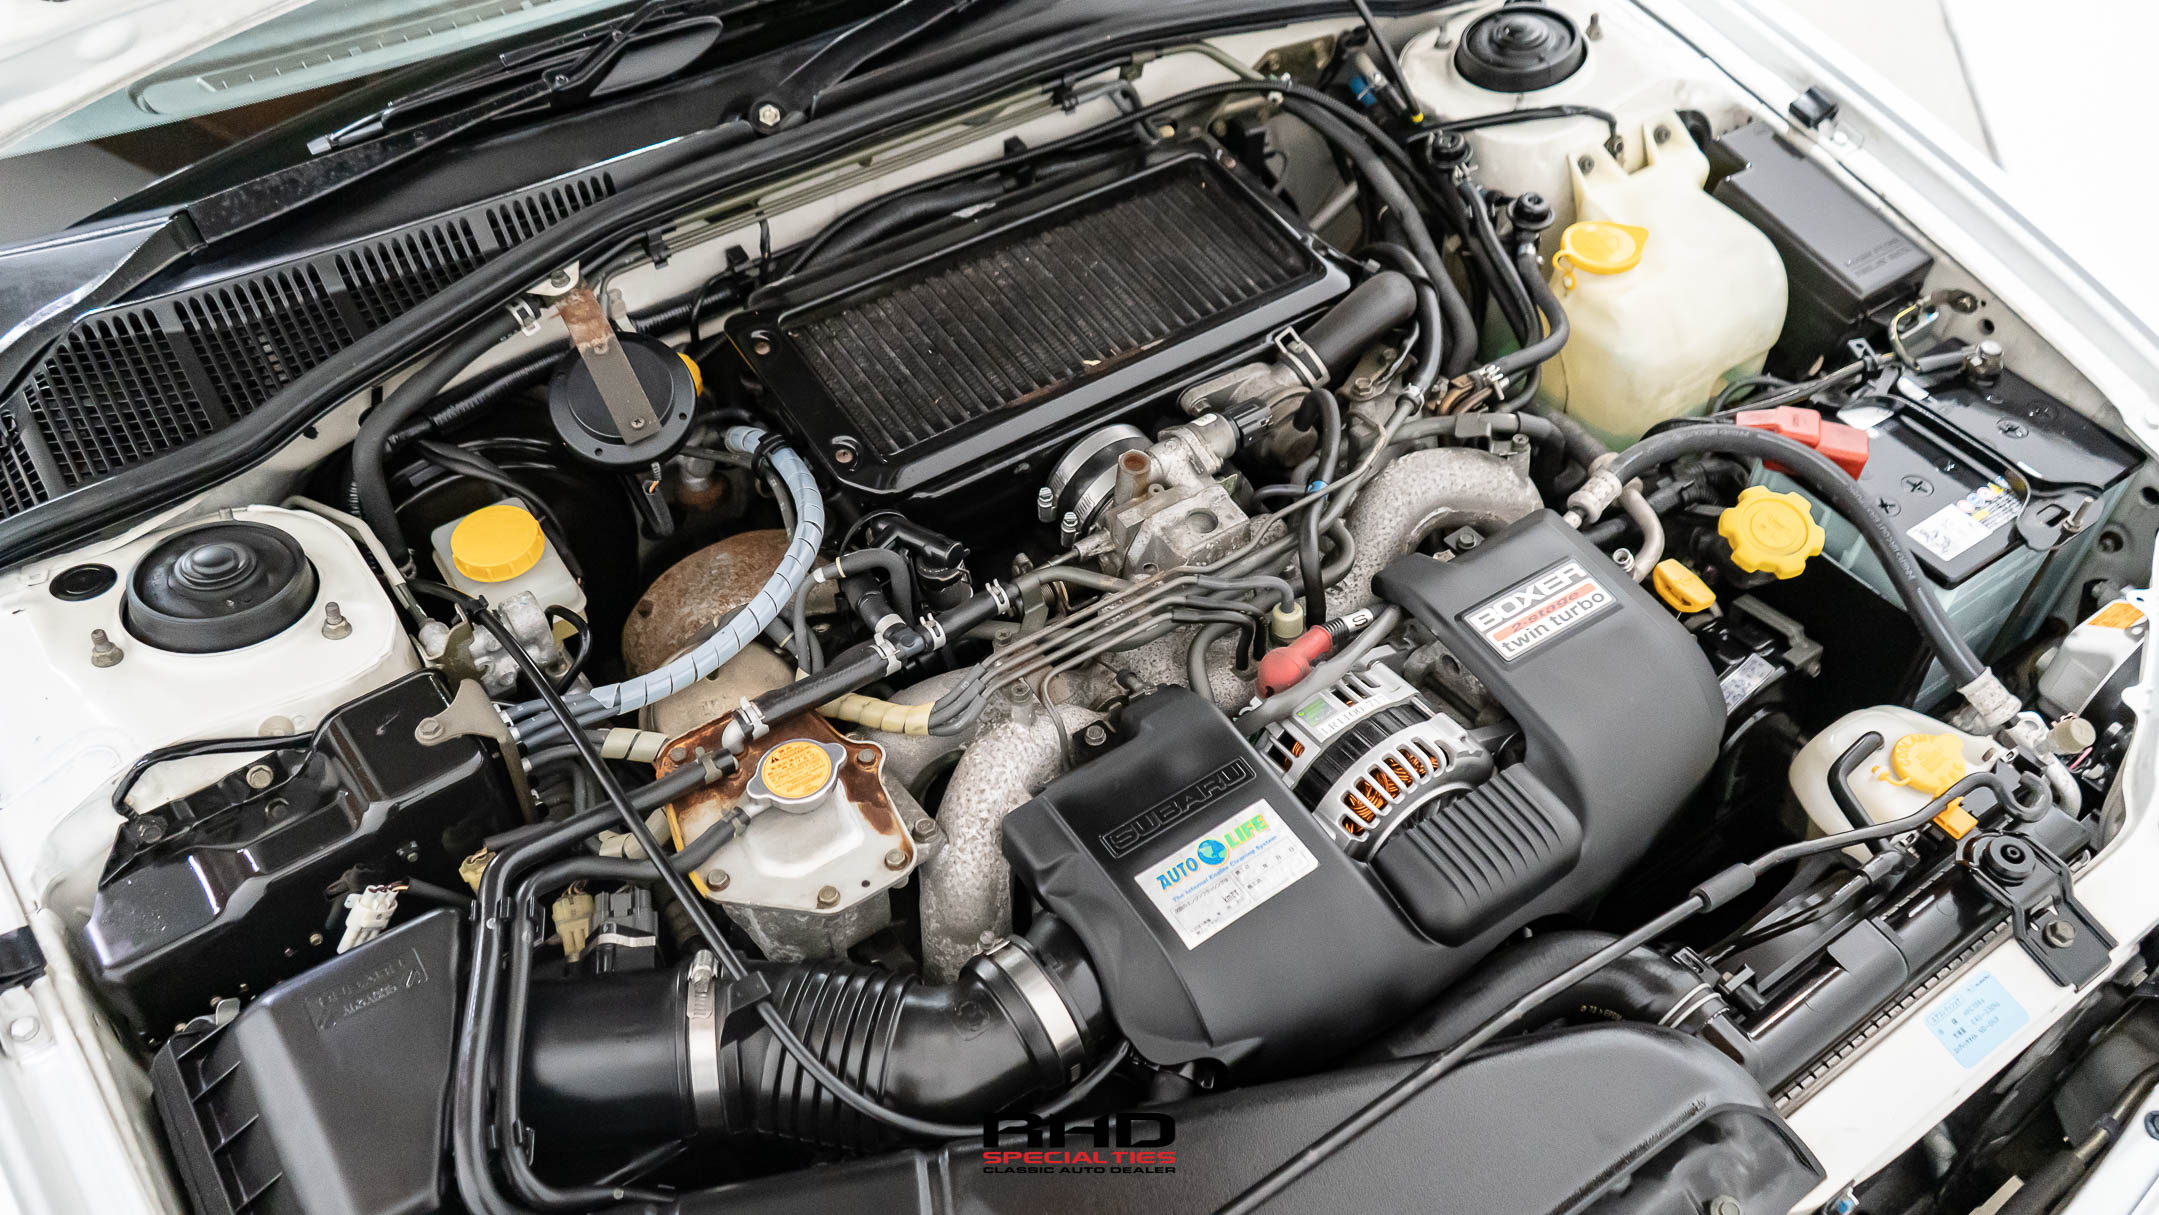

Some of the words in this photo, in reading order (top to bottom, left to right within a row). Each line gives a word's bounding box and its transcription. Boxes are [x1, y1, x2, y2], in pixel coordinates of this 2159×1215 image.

[1470, 564, 1587, 632] BOXER
[1502, 624, 1550, 653] twin
[1549, 592, 1605, 627] turbo
[1110, 761, 1247, 849] SUBARU
[1156, 857, 1199, 892] AUTO
[1224, 813, 1270, 850] LIFE
